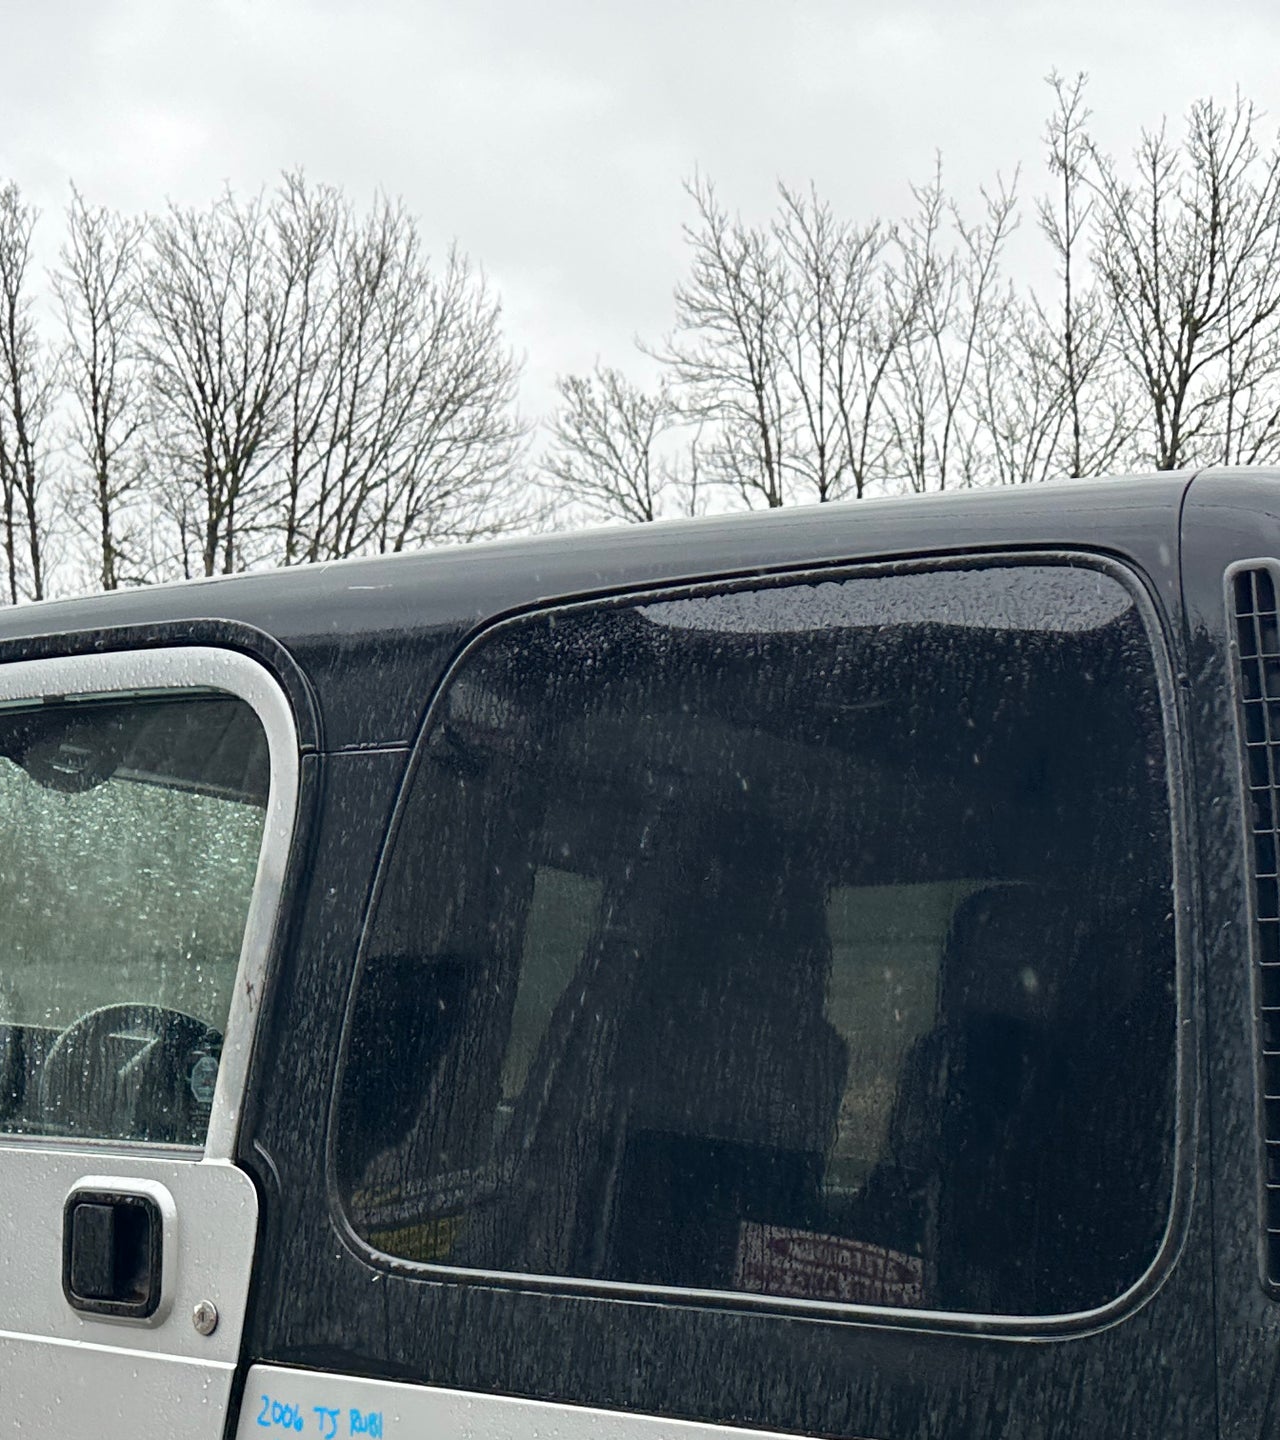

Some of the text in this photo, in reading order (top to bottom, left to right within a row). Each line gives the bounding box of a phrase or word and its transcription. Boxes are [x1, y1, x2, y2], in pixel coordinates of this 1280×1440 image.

[256, 1394, 383, 1440] 2006 TJ RUBI
